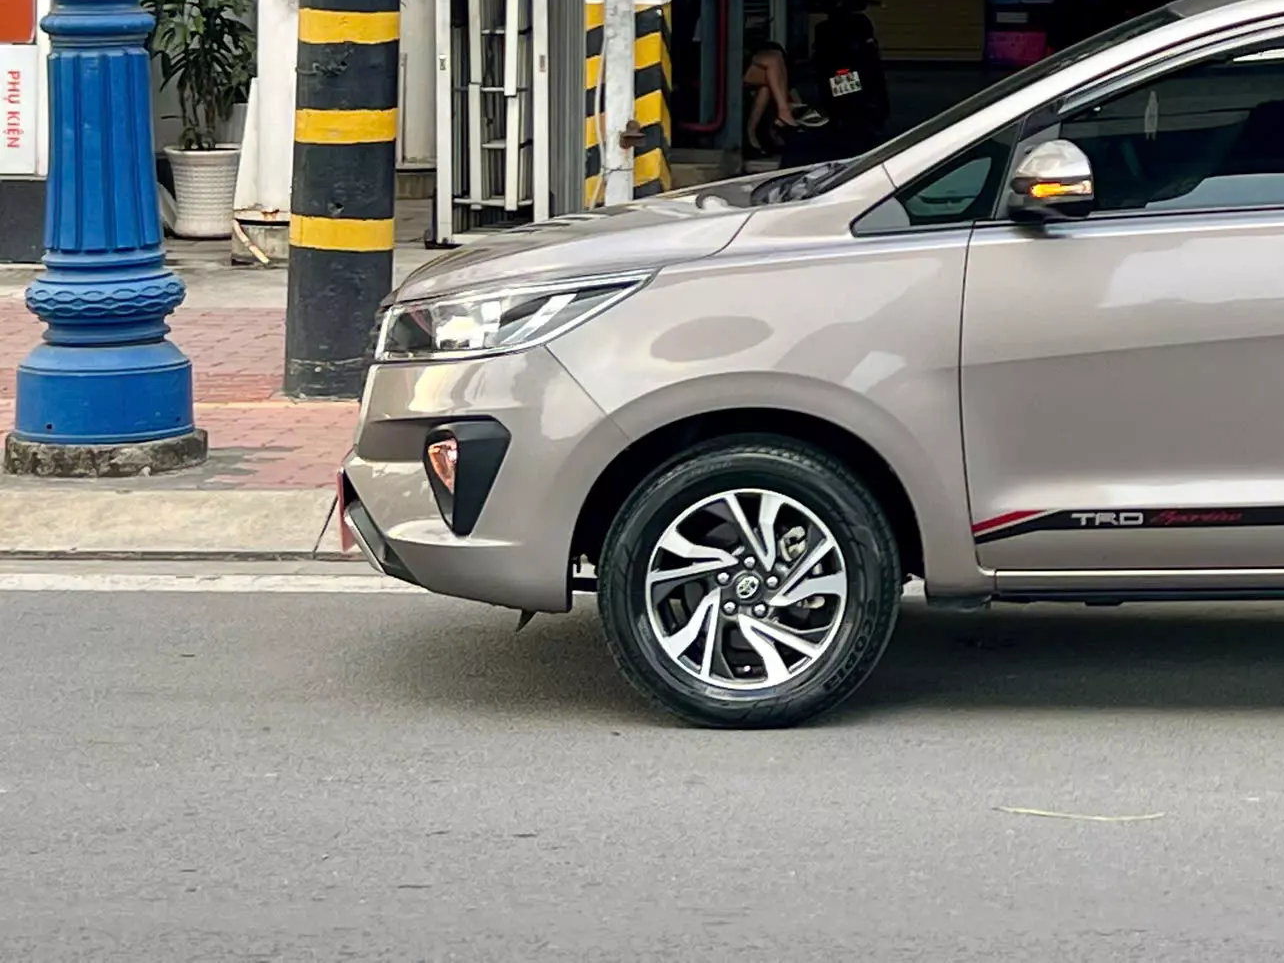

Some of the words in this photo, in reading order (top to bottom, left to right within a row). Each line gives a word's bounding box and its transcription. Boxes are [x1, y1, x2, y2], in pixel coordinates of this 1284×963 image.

[4, 70, 21, 105] PHỤ
[3, 111, 24, 149] KIỆN
[1071, 512, 1144, 526] TRD
